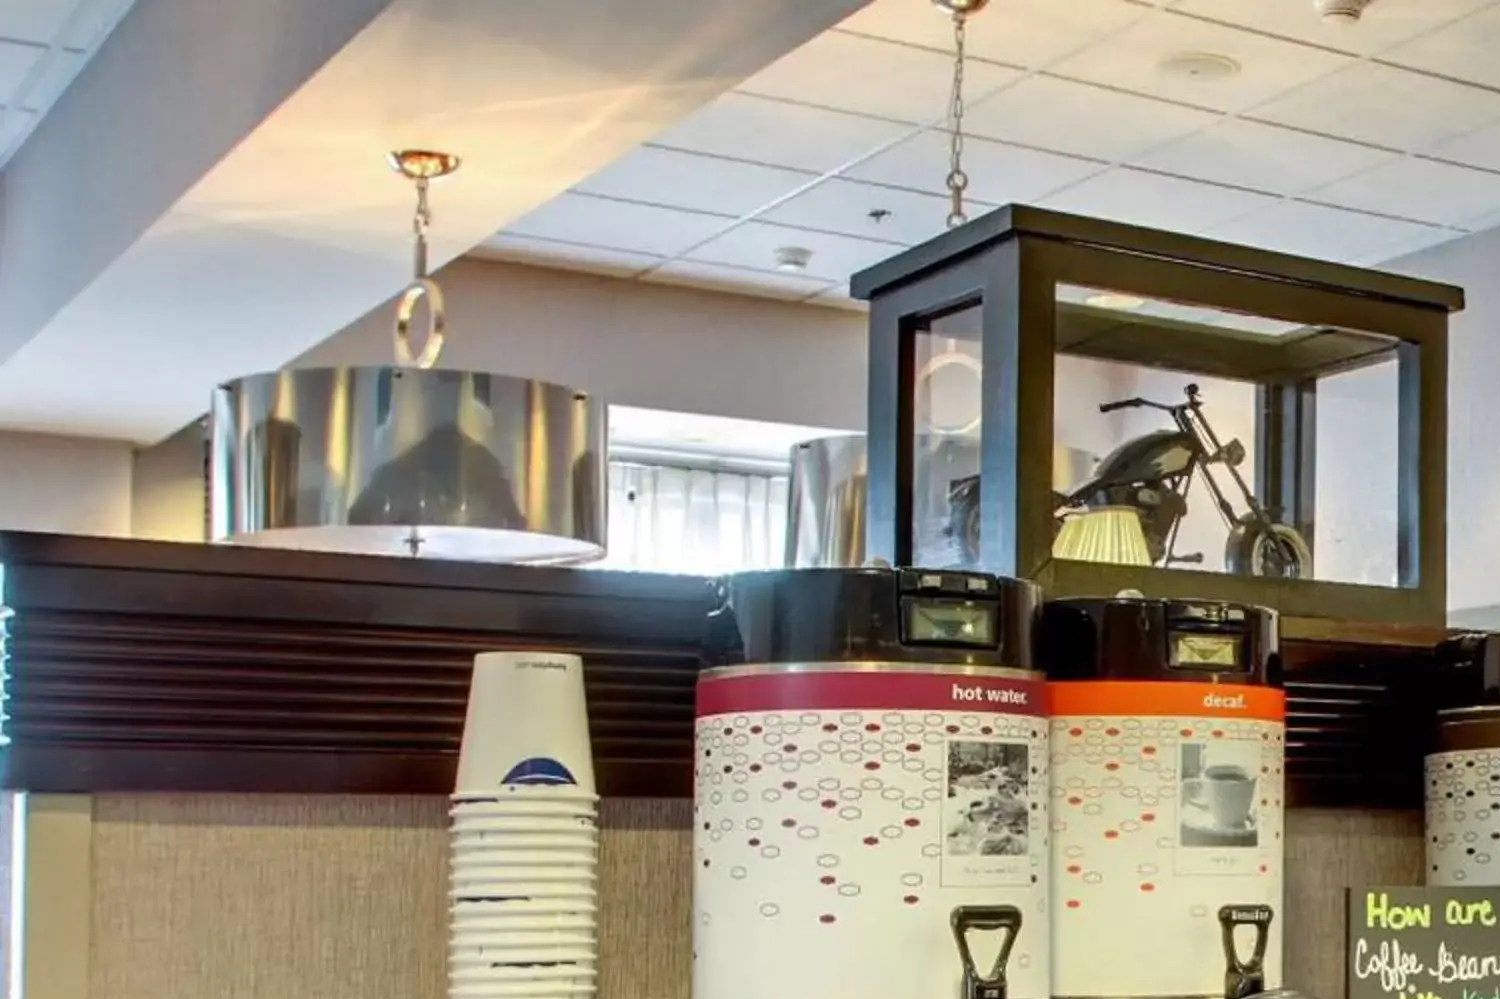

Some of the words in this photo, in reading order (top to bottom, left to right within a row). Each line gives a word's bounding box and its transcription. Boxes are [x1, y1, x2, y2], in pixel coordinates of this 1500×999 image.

[952, 683, 983, 701] hot
[1203, 691, 1248, 709] decaf.
[1366, 892, 1431, 930] How
[1446, 899, 1497, 927] are
[1355, 938, 1424, 992] Coffee
